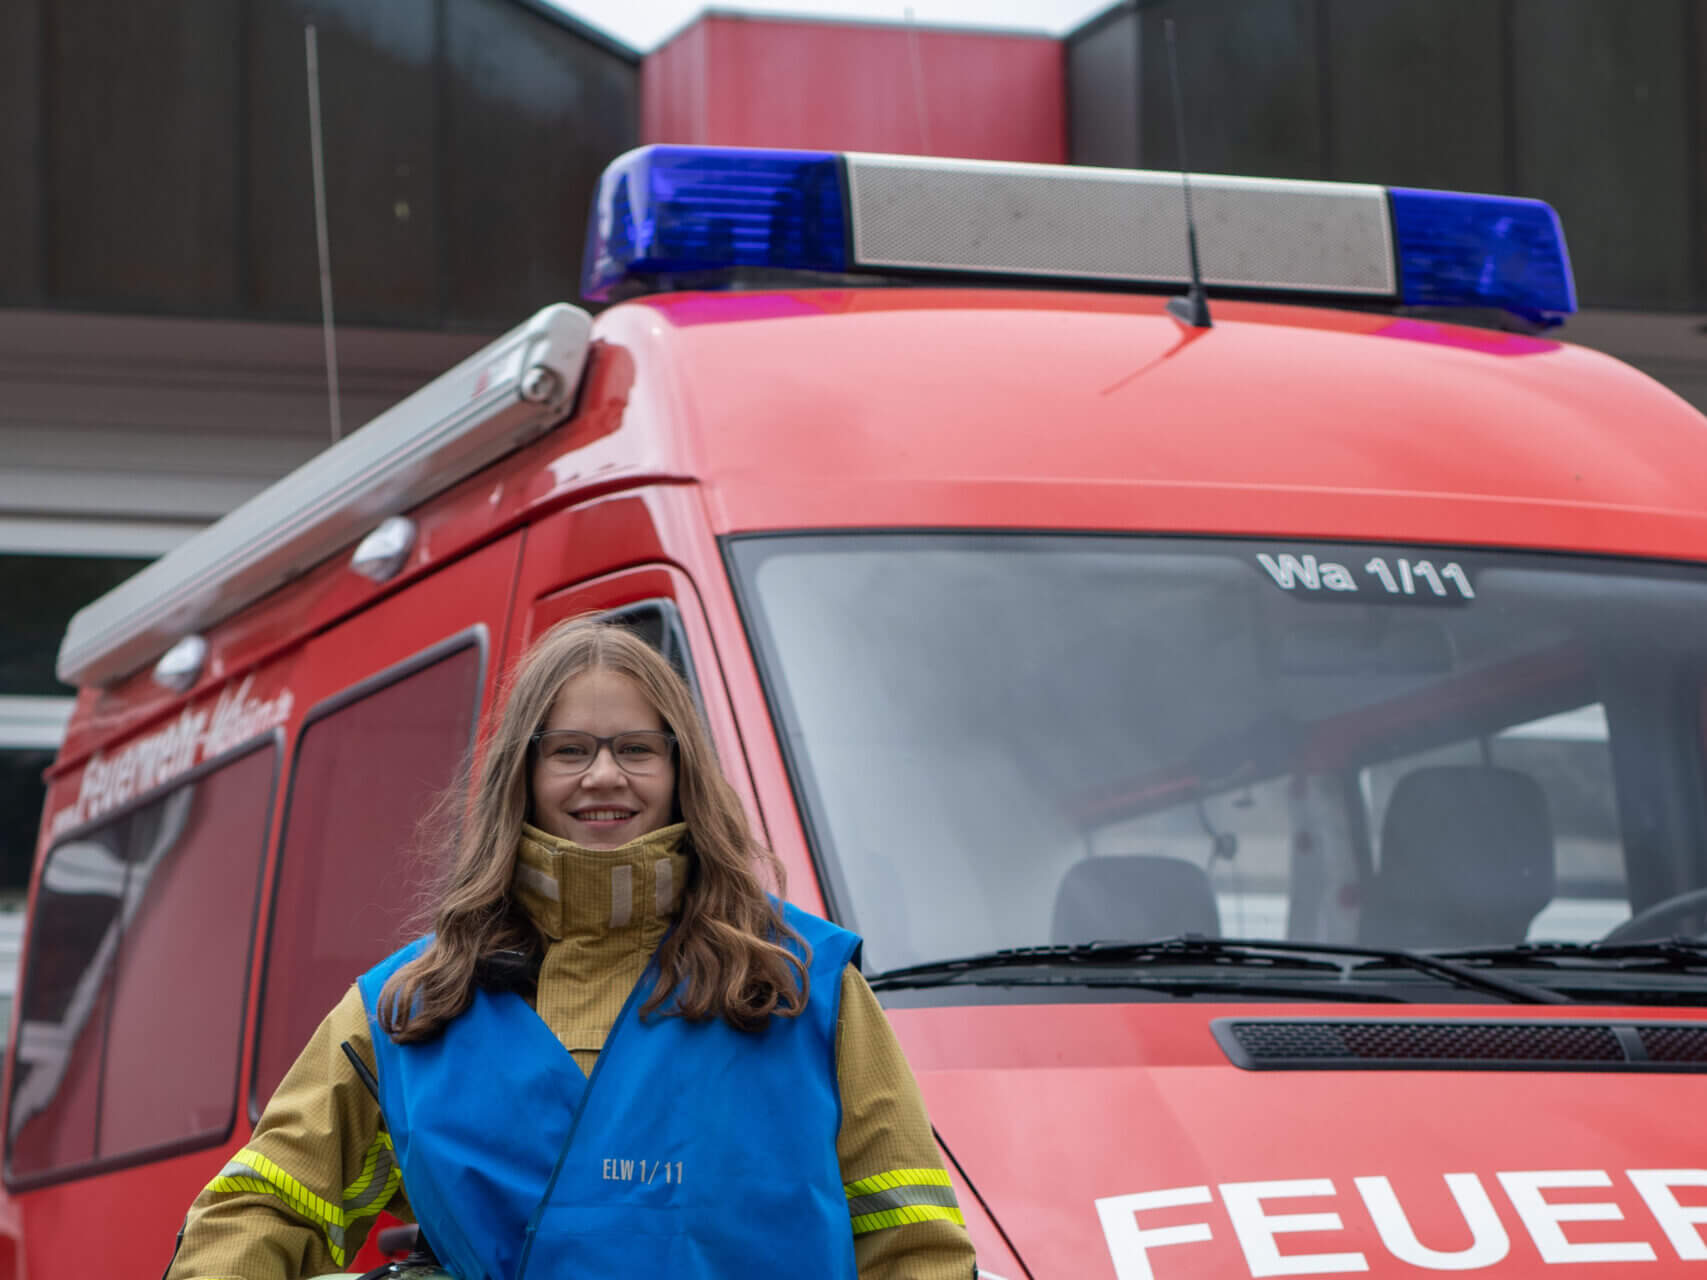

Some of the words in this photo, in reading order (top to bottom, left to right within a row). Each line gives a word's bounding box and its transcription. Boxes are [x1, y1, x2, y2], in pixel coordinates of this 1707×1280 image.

[1256, 553, 1358, 591] Wa
[1365, 557, 1475, 599] 1/11
[602, 1158, 635, 1181] ELW
